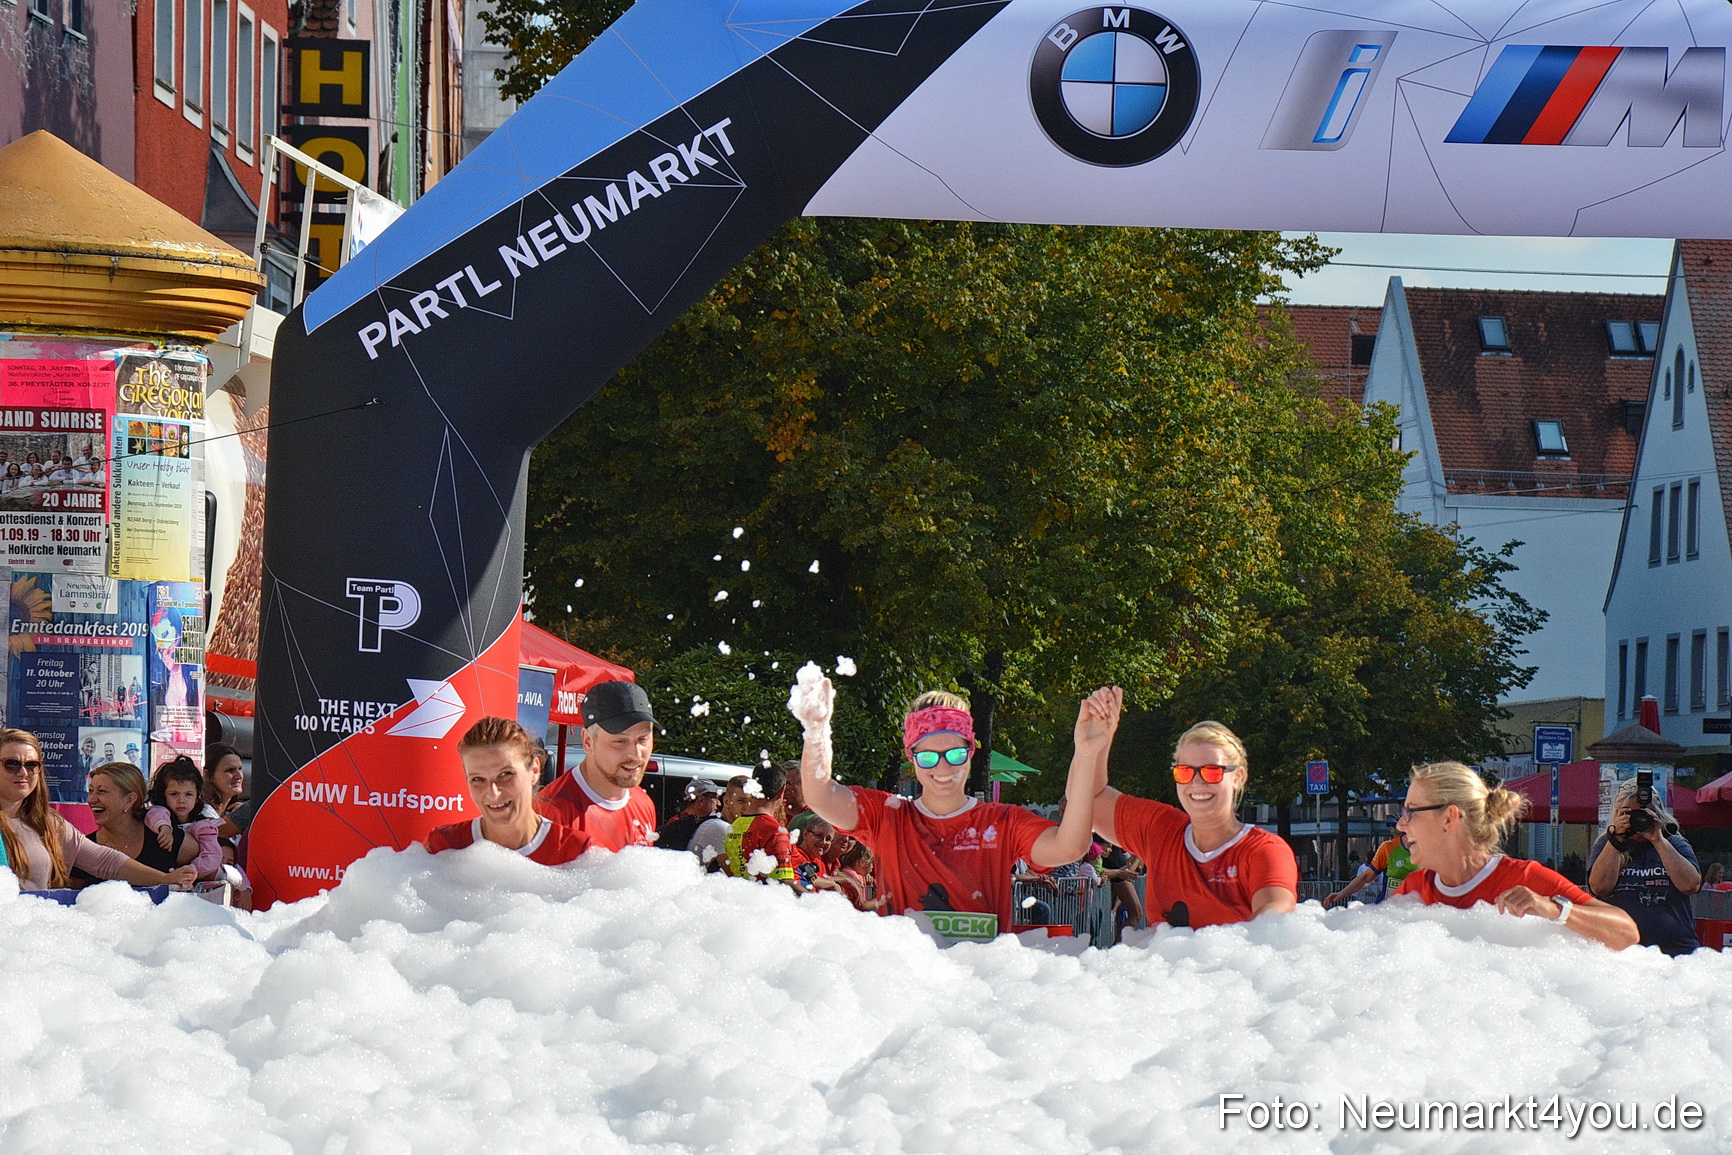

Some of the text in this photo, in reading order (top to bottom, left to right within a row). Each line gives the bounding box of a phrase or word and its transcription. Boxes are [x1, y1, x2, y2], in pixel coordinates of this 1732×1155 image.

[1047, 8, 1186, 55] BMW
[1561, 46, 1727, 147] M
[358, 116, 737, 360] PARTL NEUMARKT
[135, 363, 172, 390] The
[40, 411, 103, 430] SUNRISE
[127, 479, 154, 488] Kakteen
[161, 481, 181, 489] Verkauf
[42, 492, 102, 508] 20 JAHRE
[111, 435, 123, 575] Kakteen und andere Sukkulenten
[127, 500, 146, 508] Sonntag,
[58, 516, 64, 525] &
[66, 514, 102, 526] Konzert
[142, 517, 152, 525] Berg
[50, 528, 80, 542] 18.30
[83, 530, 102, 543] Uhr
[8, 543, 54, 556] Hofkirche
[57, 544, 102, 557] Neumarkt
[59, 590, 111, 599] Lammsbräu
[351, 583, 394, 594] Team Partl
[11, 619, 148, 637] Erntedankfest 2019
[56, 637, 130, 646] BRAUEREIHOF
[37, 658, 64, 668] Freitag
[25, 668, 75, 678] 11. Oktober
[35, 679, 65, 688] 20 Uhr
[524, 691, 544, 707] AVIA.
[318, 698, 398, 719] THE NEXT
[294, 714, 376, 735] 100 YEARS
[32, 730, 66, 740] Samstag
[38, 741, 74, 750] Oktober
[46, 751, 63, 760] Uhr
[1310, 783, 1327, 791] TAXI
[290, 780, 464, 814] BMW Laufsport
